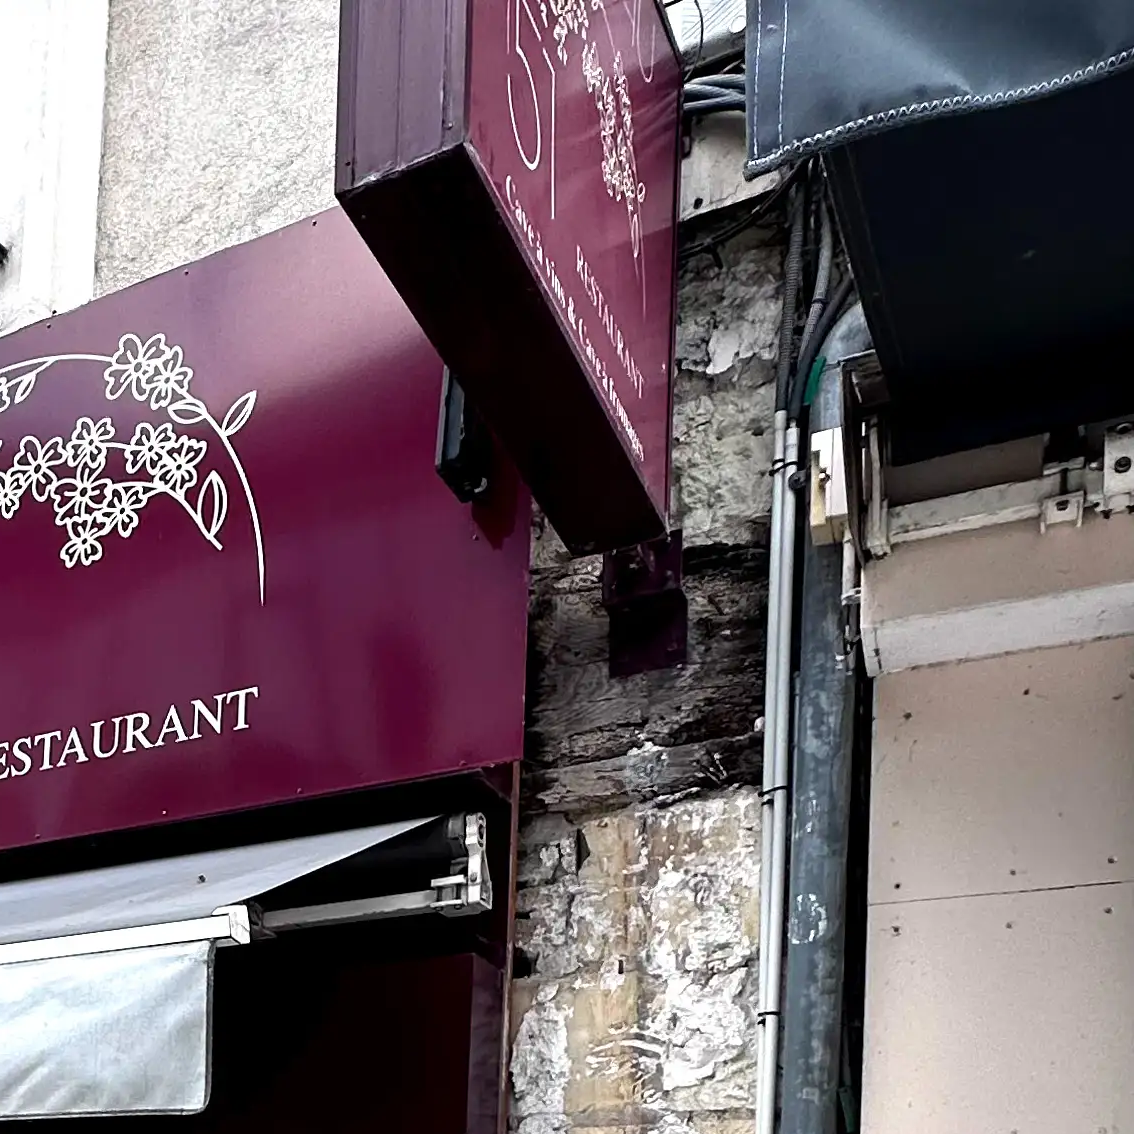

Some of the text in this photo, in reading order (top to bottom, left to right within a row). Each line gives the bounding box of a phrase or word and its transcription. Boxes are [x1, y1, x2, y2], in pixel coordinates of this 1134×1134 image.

[505, 174, 535, 248] Cave
[545, 257, 566, 309] vins
[578, 318, 602, 377] Cave
[576, 244, 645, 399] RESTAURANT
